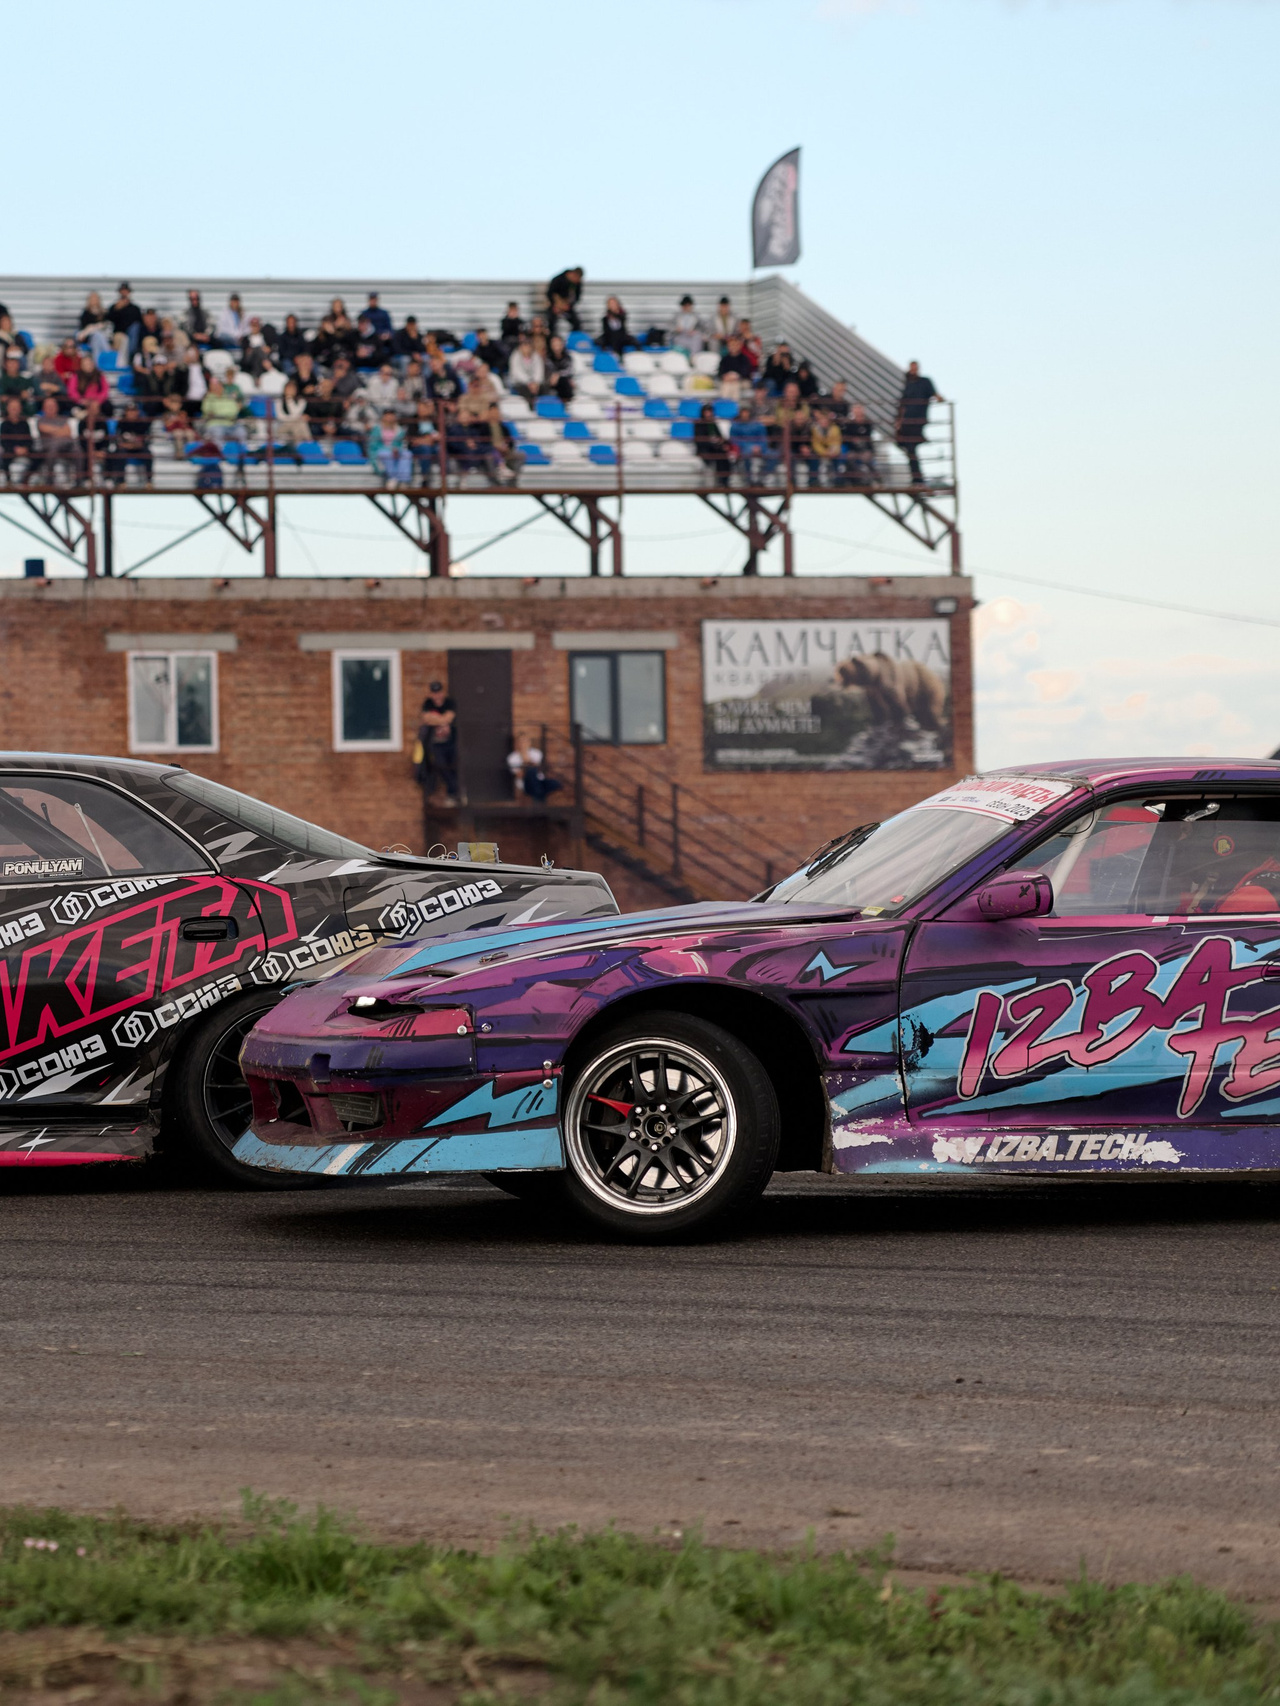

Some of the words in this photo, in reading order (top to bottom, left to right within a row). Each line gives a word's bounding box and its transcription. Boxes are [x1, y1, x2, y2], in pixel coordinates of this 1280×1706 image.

[714, 628, 950, 667] КАМЧАТКА
[1005, 803, 1036, 817] 2025
[4, 858, 83, 876] PONULYAM
[419, 878, 503, 922] СОЮЗ
[292, 924, 376, 970] СОЮЗ
[157, 973, 242, 1029] СОЮЗ
[16, 1034, 107, 1084] СОЮЗ
